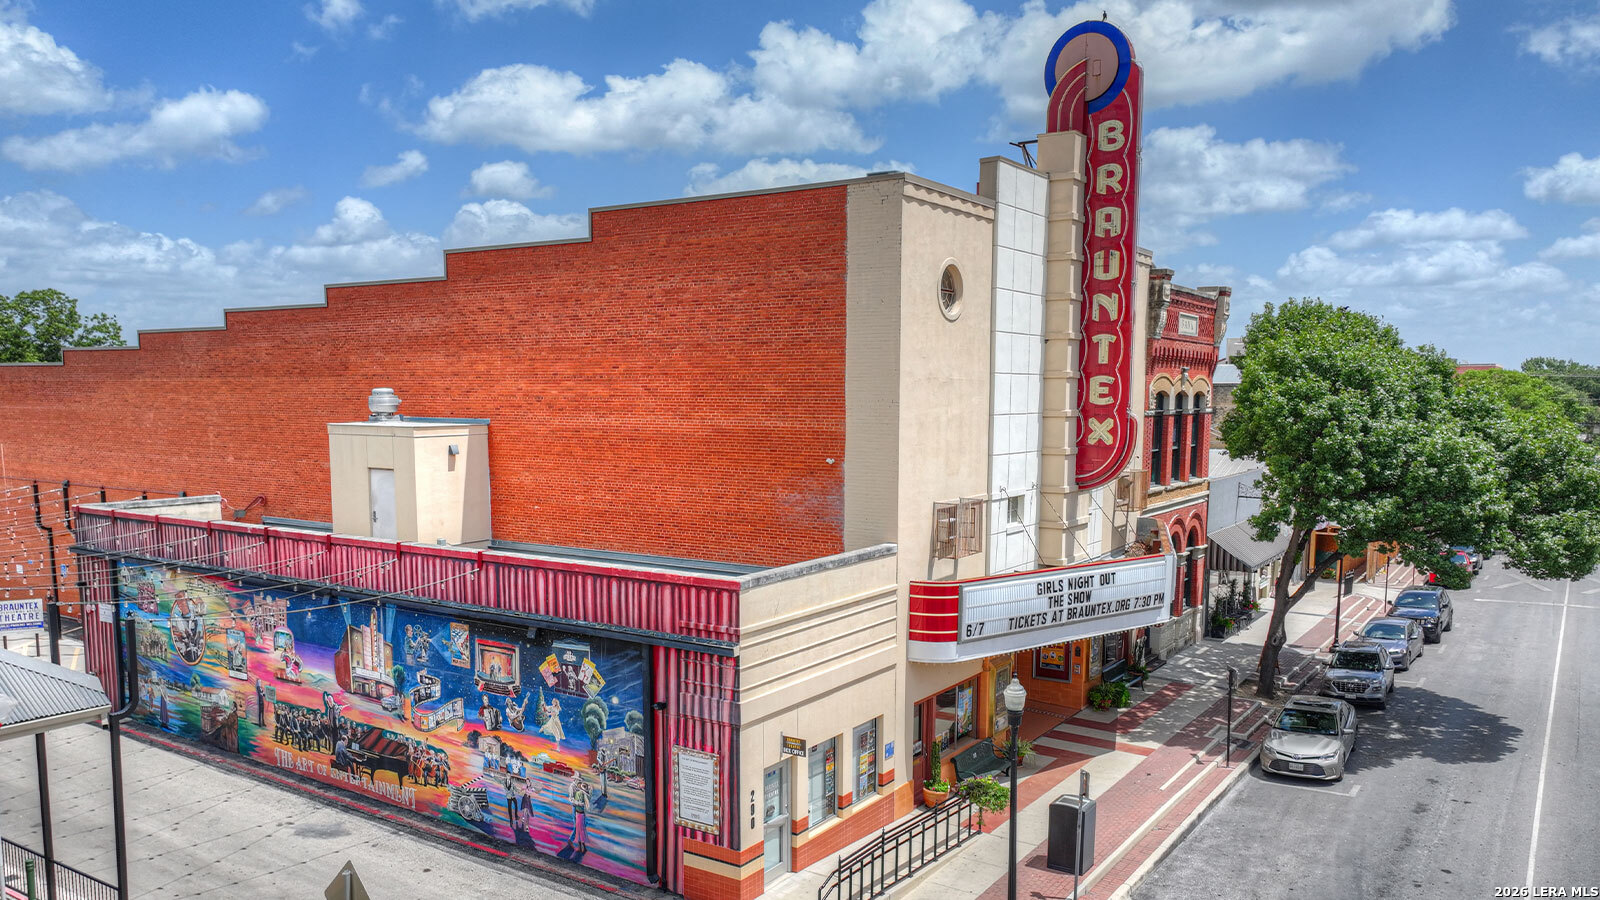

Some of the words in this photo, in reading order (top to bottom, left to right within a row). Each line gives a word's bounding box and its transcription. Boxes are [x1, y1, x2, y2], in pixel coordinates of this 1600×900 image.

[1087, 119, 1126, 446] BRAUNTEX
[1036, 579, 1064, 596] GIRLS
[1067, 574, 1095, 592] NIGHT
[1099, 572, 1116, 586] OUT
[1048, 595, 1064, 609] THE
[1067, 590, 1092, 606] SHOW
[0, 612, 40, 622] THEATRE
[965, 621, 985, 638] 6/7
[1008, 612, 1047, 631] TICKETS
[1051, 608, 1064, 623] AT
[1066, 598, 1131, 620] BRAUNTEX.ORG
[1133, 595, 1151, 610] 7:30
[1150, 592, 1165, 606] PM
[274, 747, 294, 769] THE
[296, 756, 315, 773] ART
[317, 763, 328, 776] OF
[330, 767, 417, 809] ENTERTAINMENT
